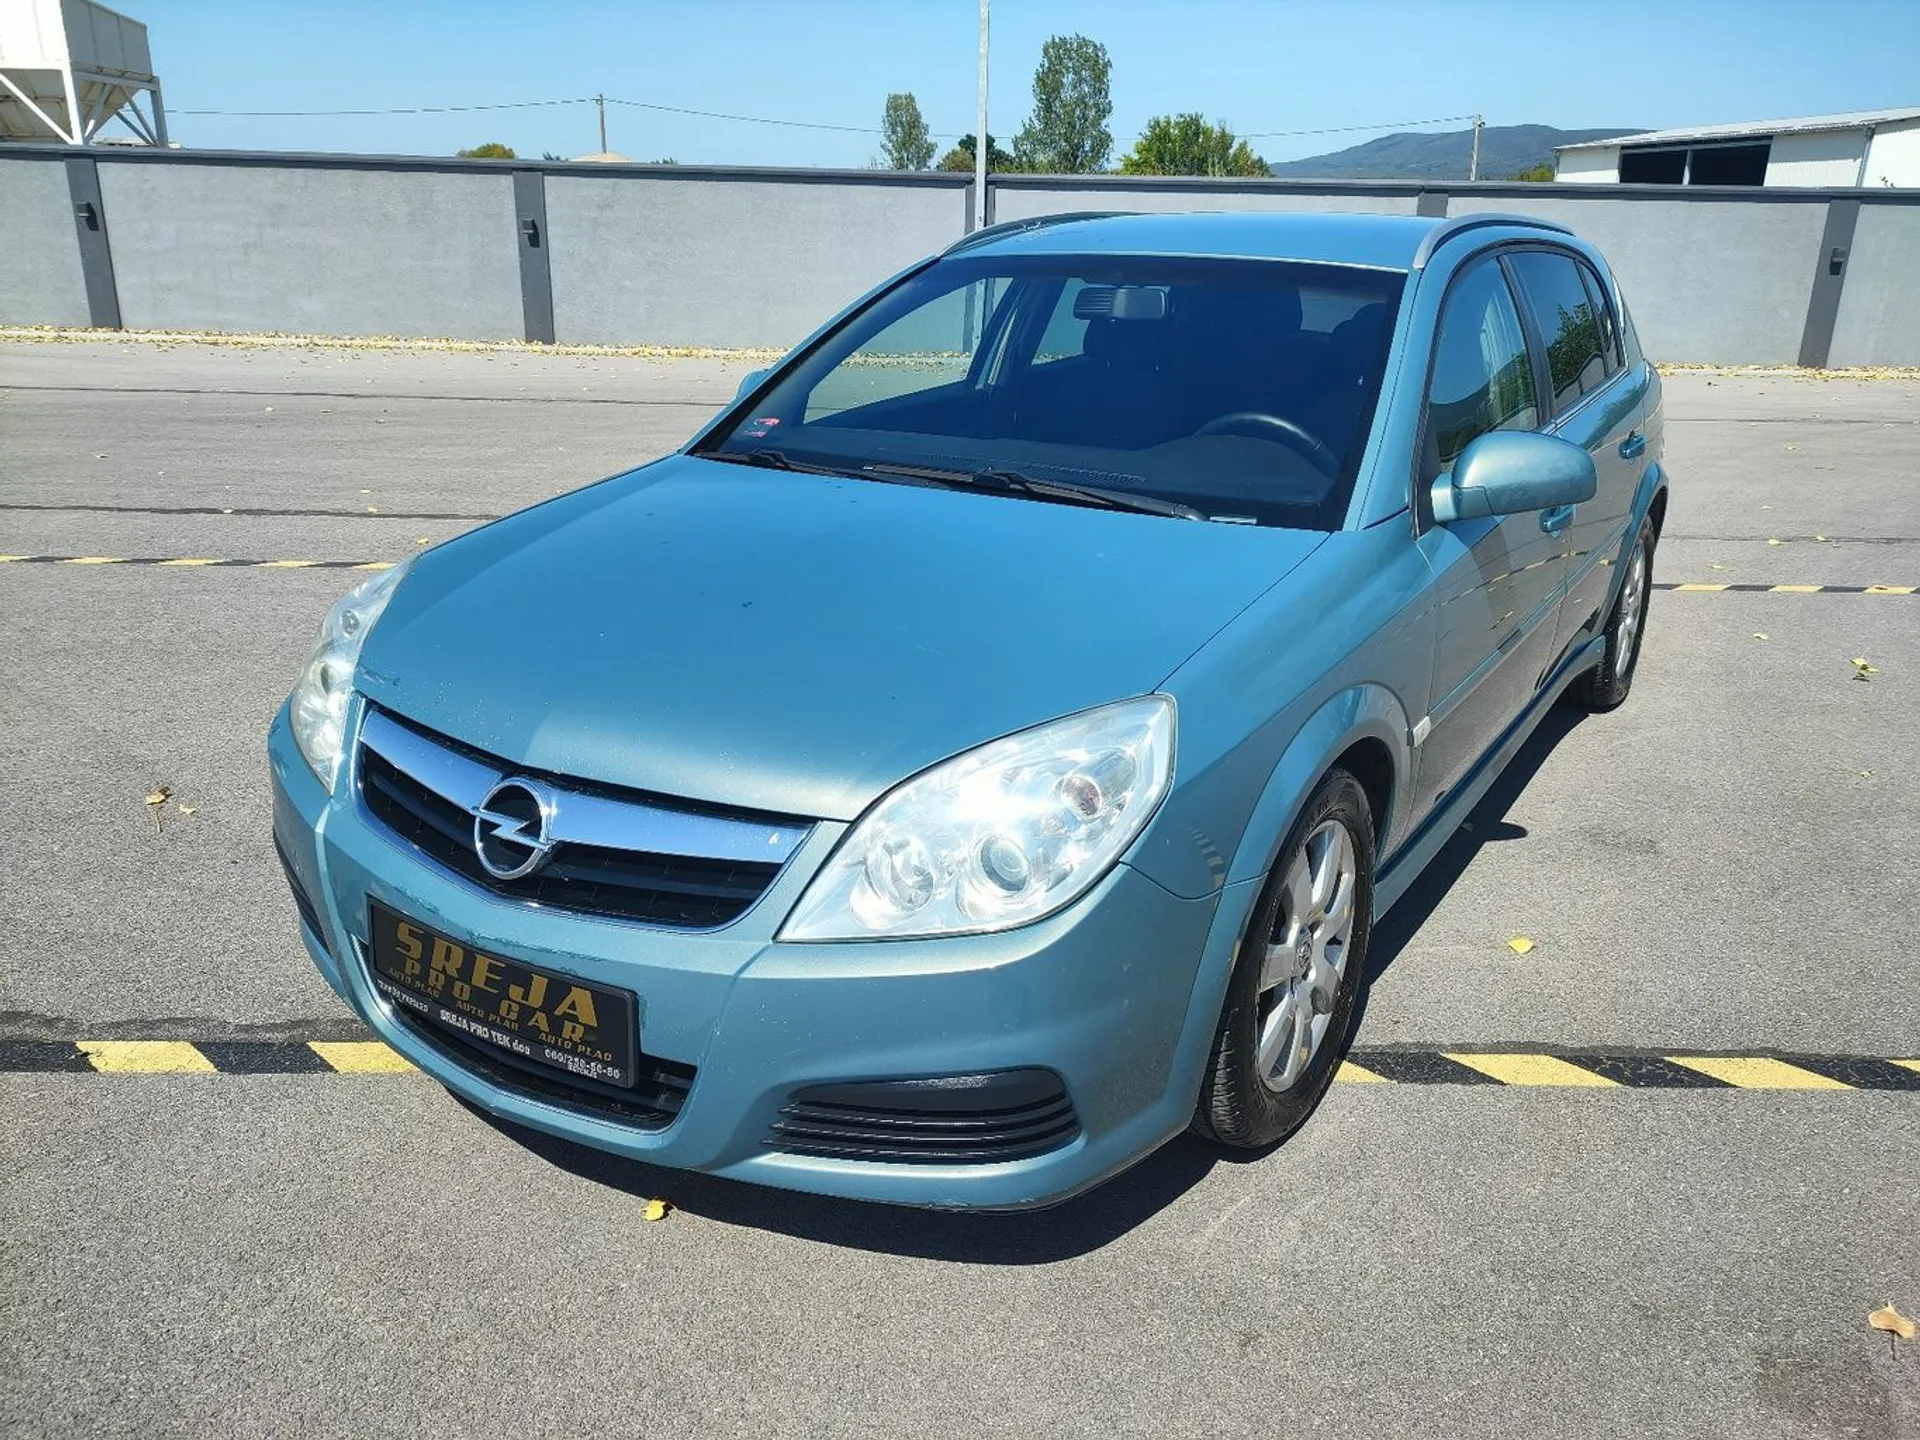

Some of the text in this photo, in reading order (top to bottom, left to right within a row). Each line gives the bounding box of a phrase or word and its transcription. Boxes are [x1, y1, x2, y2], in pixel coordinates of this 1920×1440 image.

[395, 920, 598, 1028] SREJA
[403, 955, 472, 1002] PRO
[499, 999, 585, 1044] CAR
[456, 1000, 485, 1018] AUTO
[469, 1021, 490, 1038] PRO
[539, 1032, 573, 1049] AUTO
